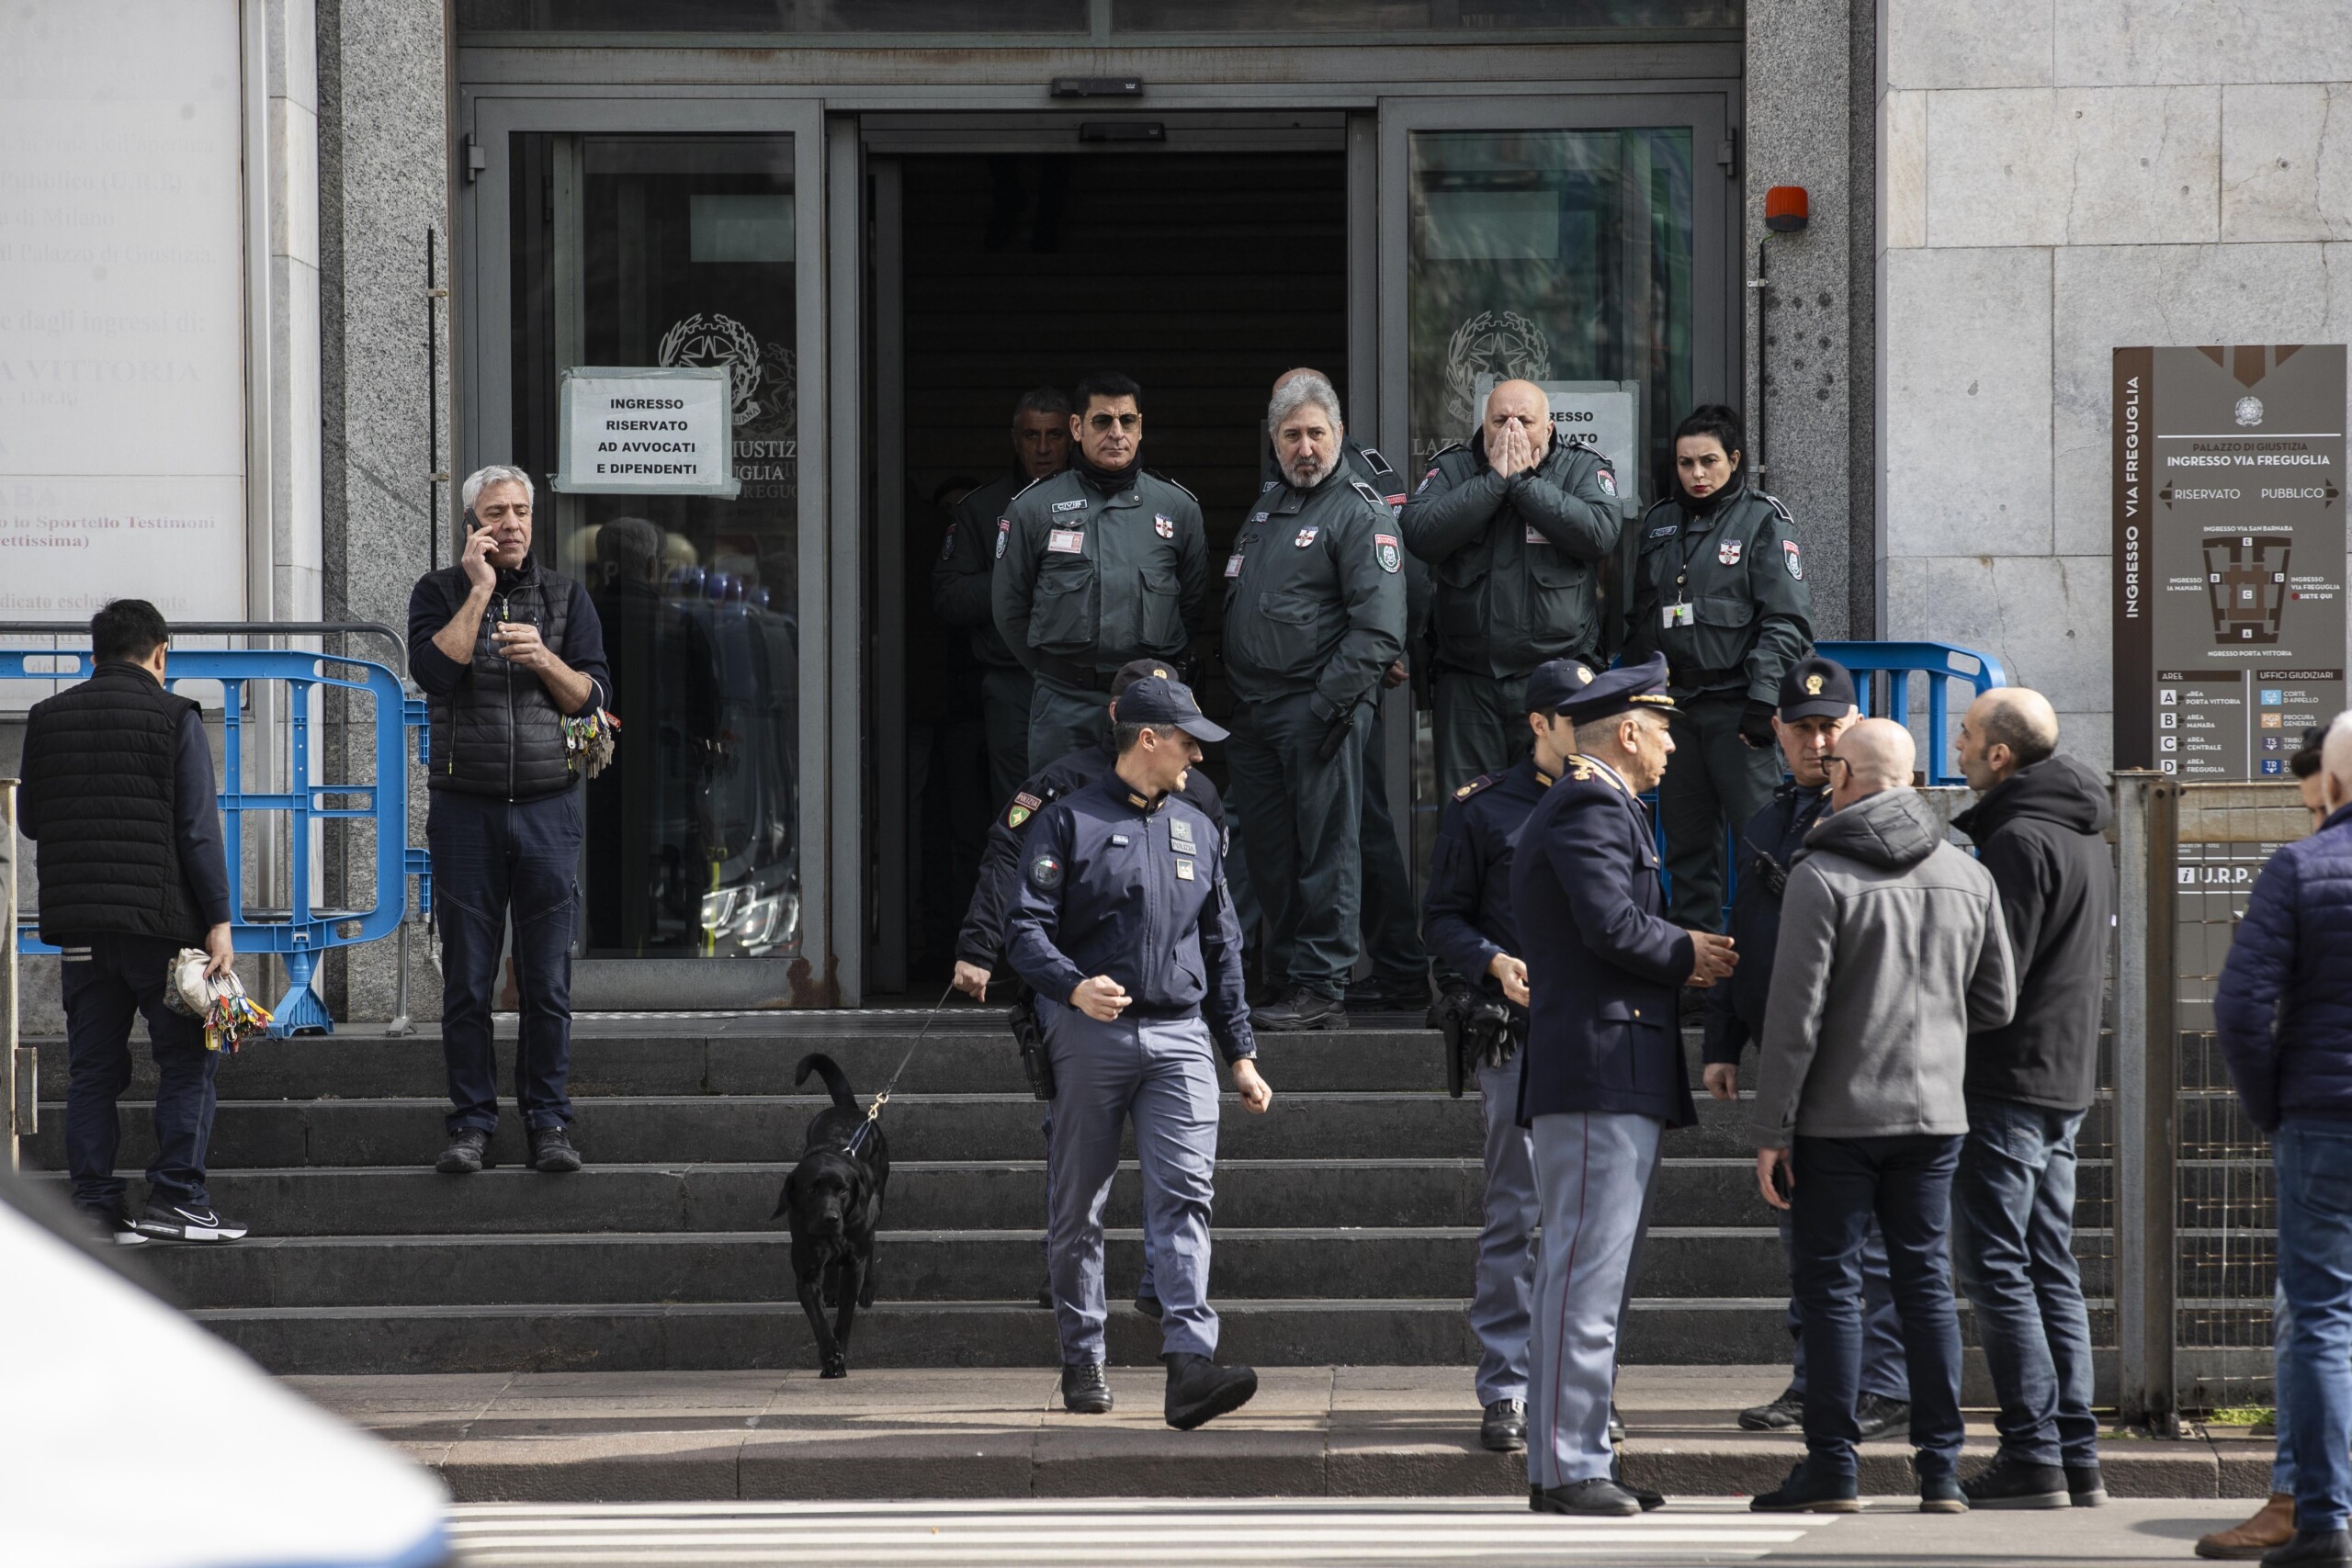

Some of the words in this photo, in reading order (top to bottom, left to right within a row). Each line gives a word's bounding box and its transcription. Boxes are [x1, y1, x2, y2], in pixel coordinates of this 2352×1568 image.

[0, 171, 95, 190] Pubblico
[16, 206, 34, 226] di
[43, 207, 115, 226] Milano
[21, 243, 94, 263] Palazzo
[100, 243, 119, 263] di
[19, 310, 74, 337] dagli
[83, 310, 167, 338] ingressi
[176, 311, 204, 333] di:
[26, 359, 200, 382] VITTORIA
[610, 399, 684, 409] INGRESSO
[606, 420, 688, 431] RISERVATO
[2126, 377, 2139, 482] FREGUGLIA
[598, 442, 617, 452] AD
[621, 442, 695, 453] AVVOCATI
[2193, 443, 2242, 452] PALAZZO
[2244, 443, 2255, 451] DI
[2256, 442, 2308, 451] GIUSTIZIA
[2167, 456, 2232, 467] INGRESSO
[2233, 456, 2256, 466] VIA
[2257, 455, 2331, 466] FREGUGLIA
[597, 464, 605, 473] E
[610, 463, 697, 474] DIPENDENTI
[2175, 489, 2241, 500] RISERVATO
[2261, 488, 2324, 499] PUBBLICO
[2126, 486, 2139, 517] VIA
[14, 516, 30, 528] lo
[36, 515, 119, 532] Sportello
[125, 516, 215, 529] Testimoni
[2126, 525, 2139, 618] INGRESSO
[2165, 692, 2174, 703] A
[2165, 715, 2174, 726] B
[2164, 738, 2174, 749] C
[2165, 761, 2174, 773] D
[1017, 793, 1039, 808] POLIZIA
[1170, 841, 1196, 853] POLIZIA
[2199, 867, 2253, 884] U.R.P.
